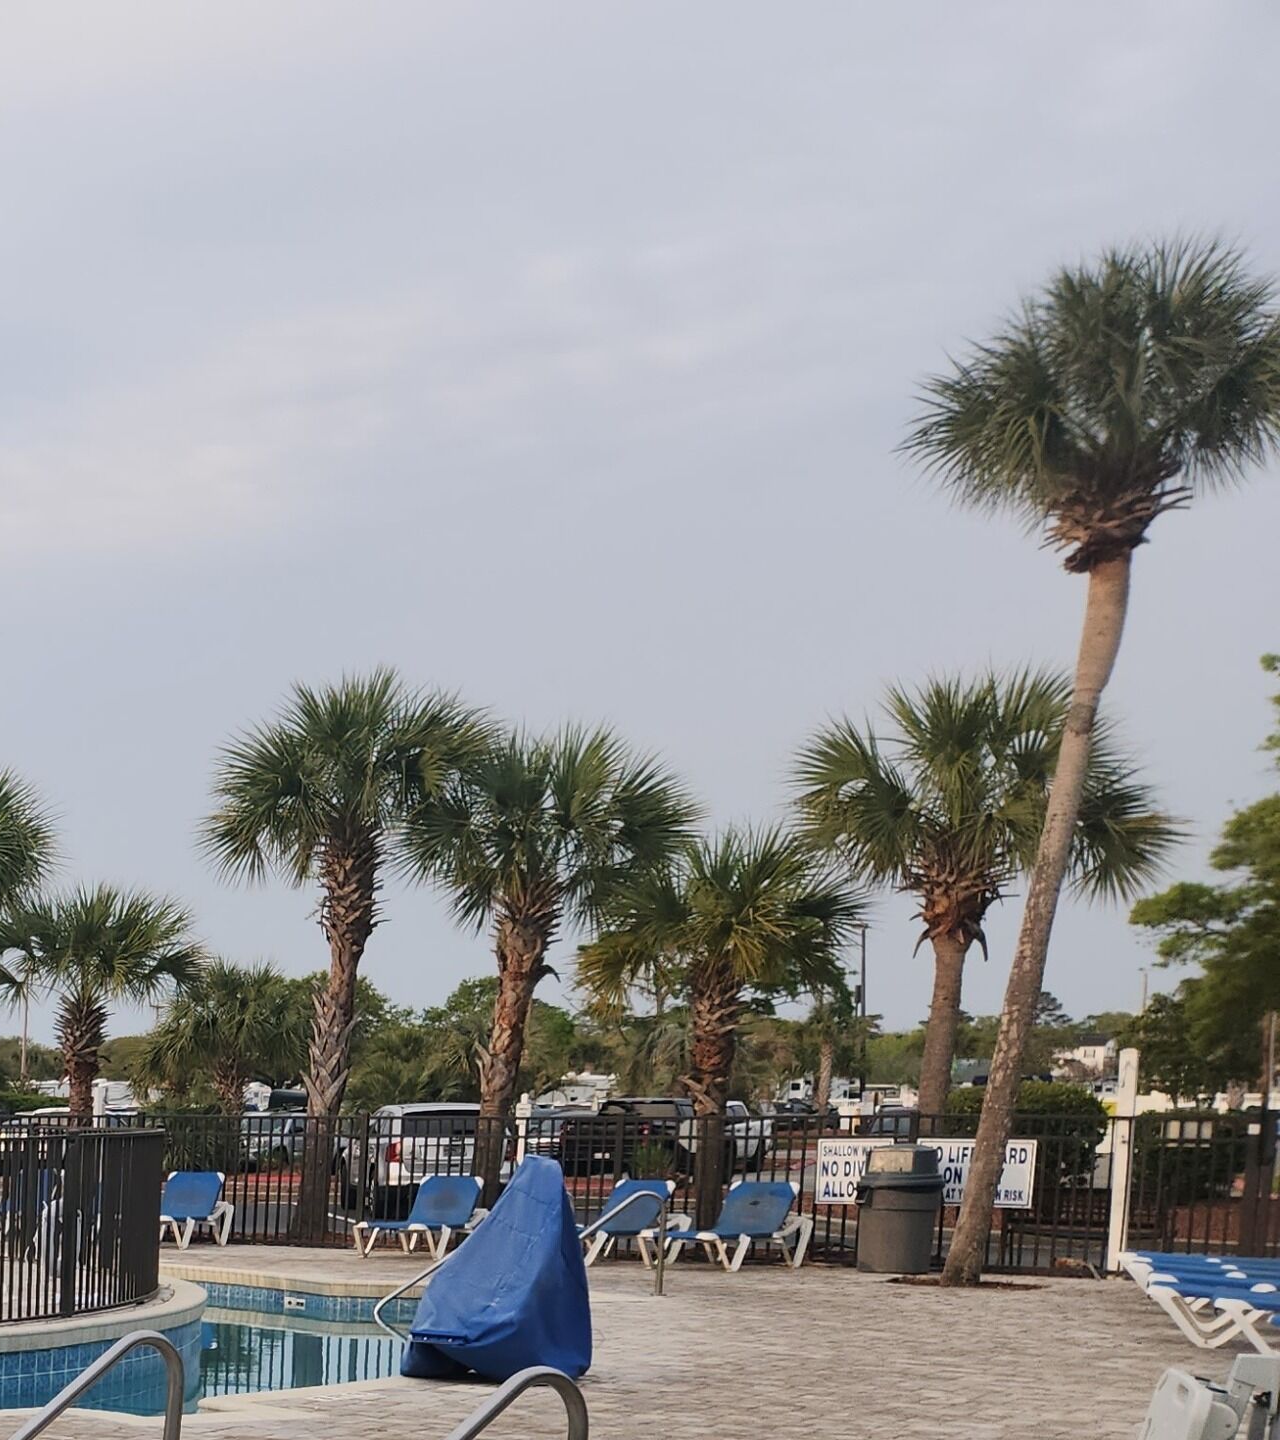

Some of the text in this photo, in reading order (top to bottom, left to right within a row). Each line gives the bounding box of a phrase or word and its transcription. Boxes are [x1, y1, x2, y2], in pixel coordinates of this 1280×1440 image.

[823, 1145, 859, 1157] SHALLOW
[822, 1161, 865, 1177] NO DIV
[944, 1166, 963, 1184] ON
[823, 1181, 854, 1198] ALLO
[946, 1188, 956, 1199] AT
[1004, 1189, 1024, 1201] RISK
